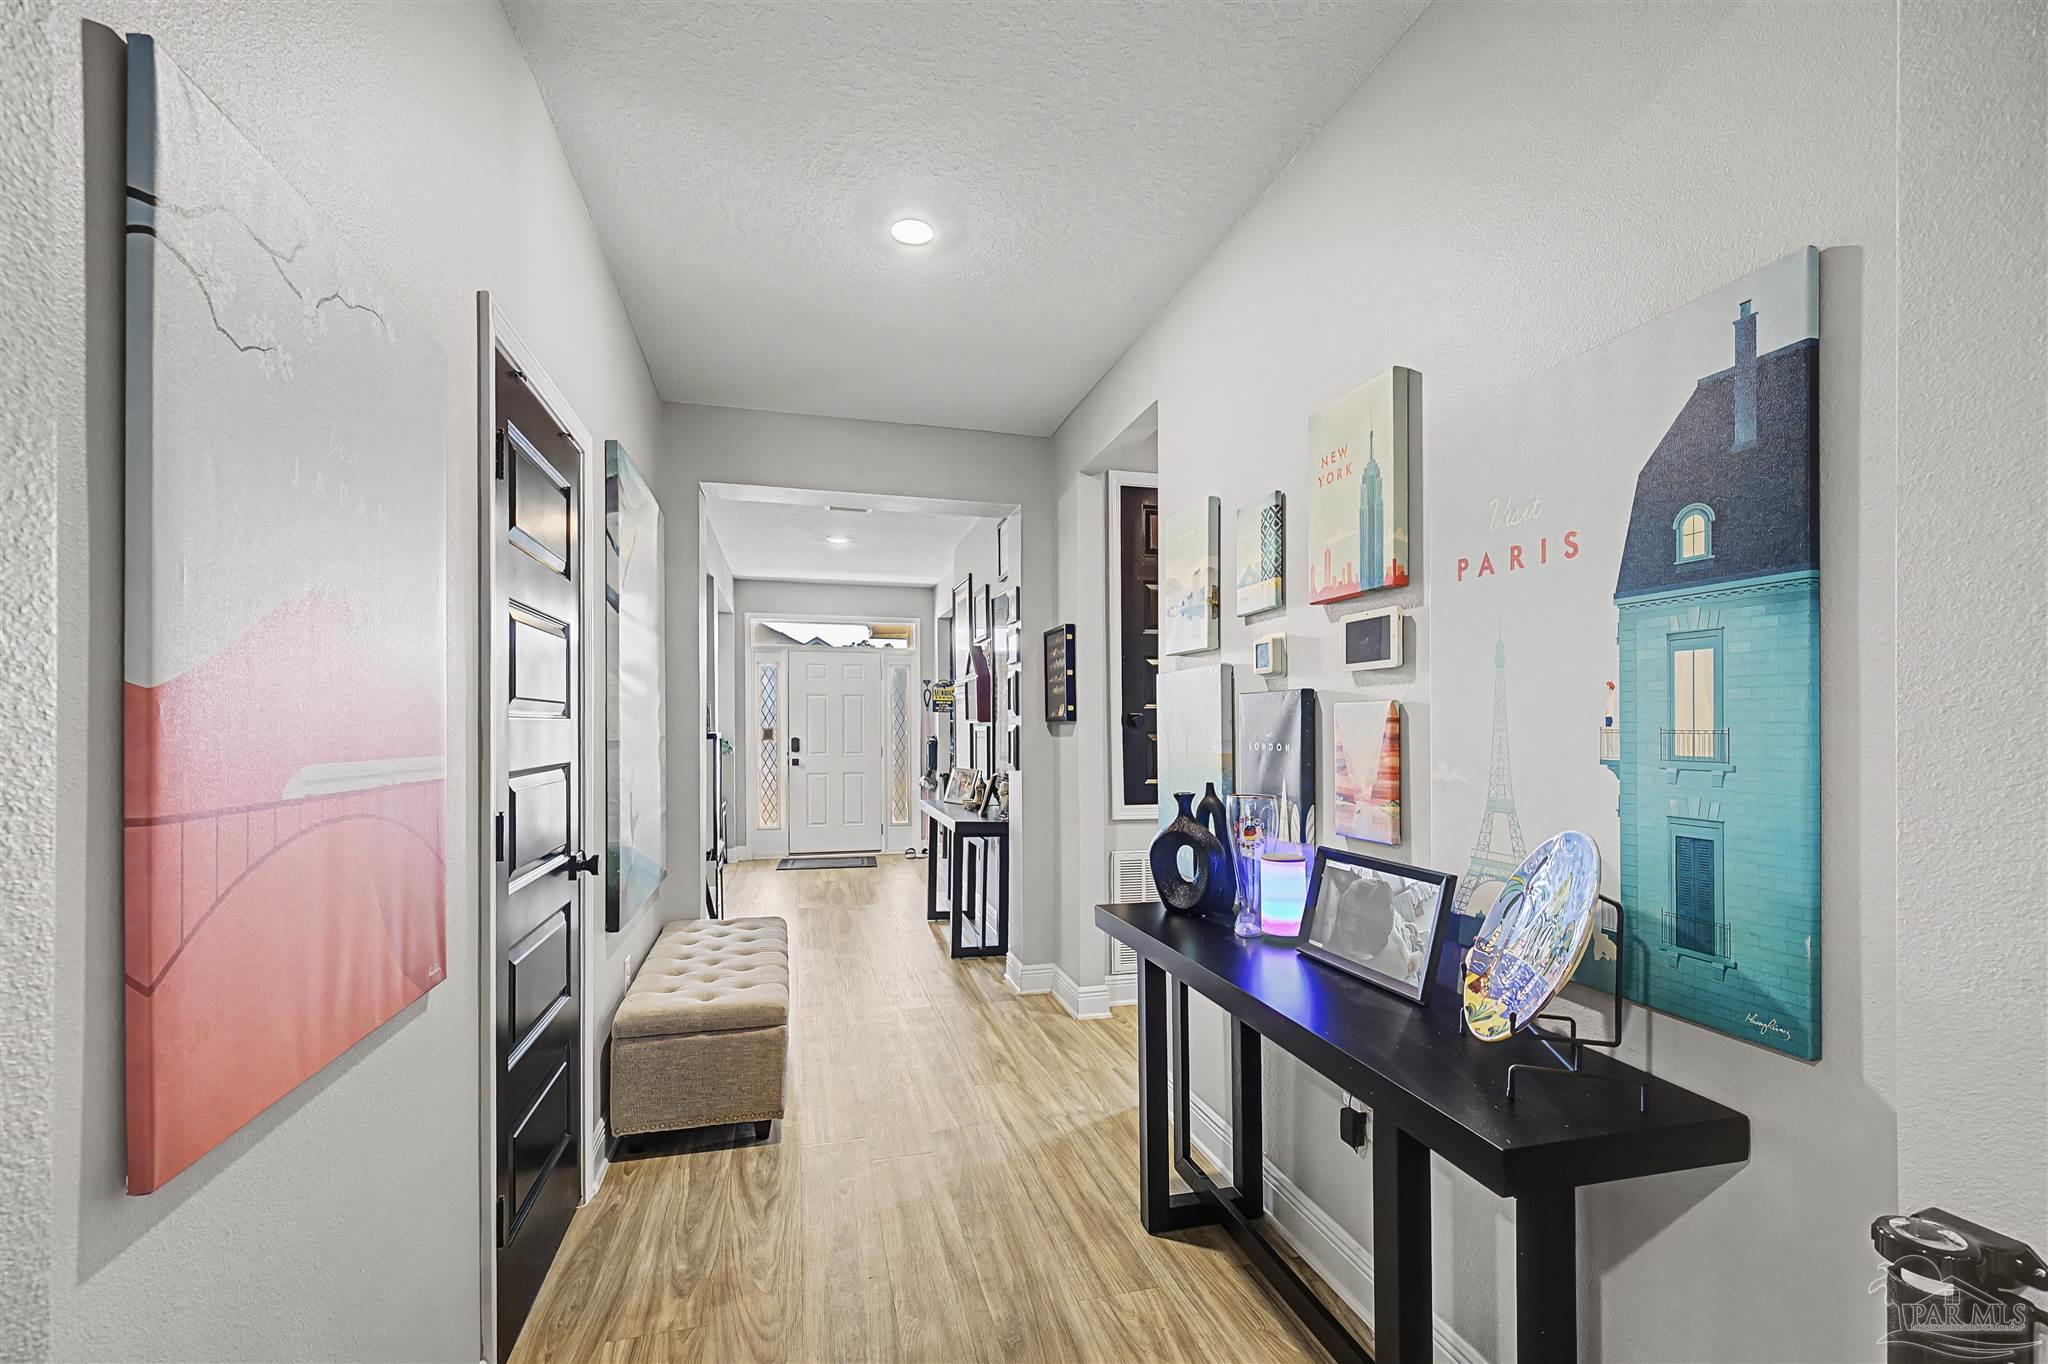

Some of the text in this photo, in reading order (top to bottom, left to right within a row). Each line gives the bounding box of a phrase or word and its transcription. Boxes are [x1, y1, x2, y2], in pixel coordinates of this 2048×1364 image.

[1321, 445, 1348, 469] NEW
[1317, 462, 1352, 488] YORK
[1488, 493, 1543, 531] Visit
[1457, 531, 1580, 581] PARIS
[1248, 742, 1291, 752] LONDON
